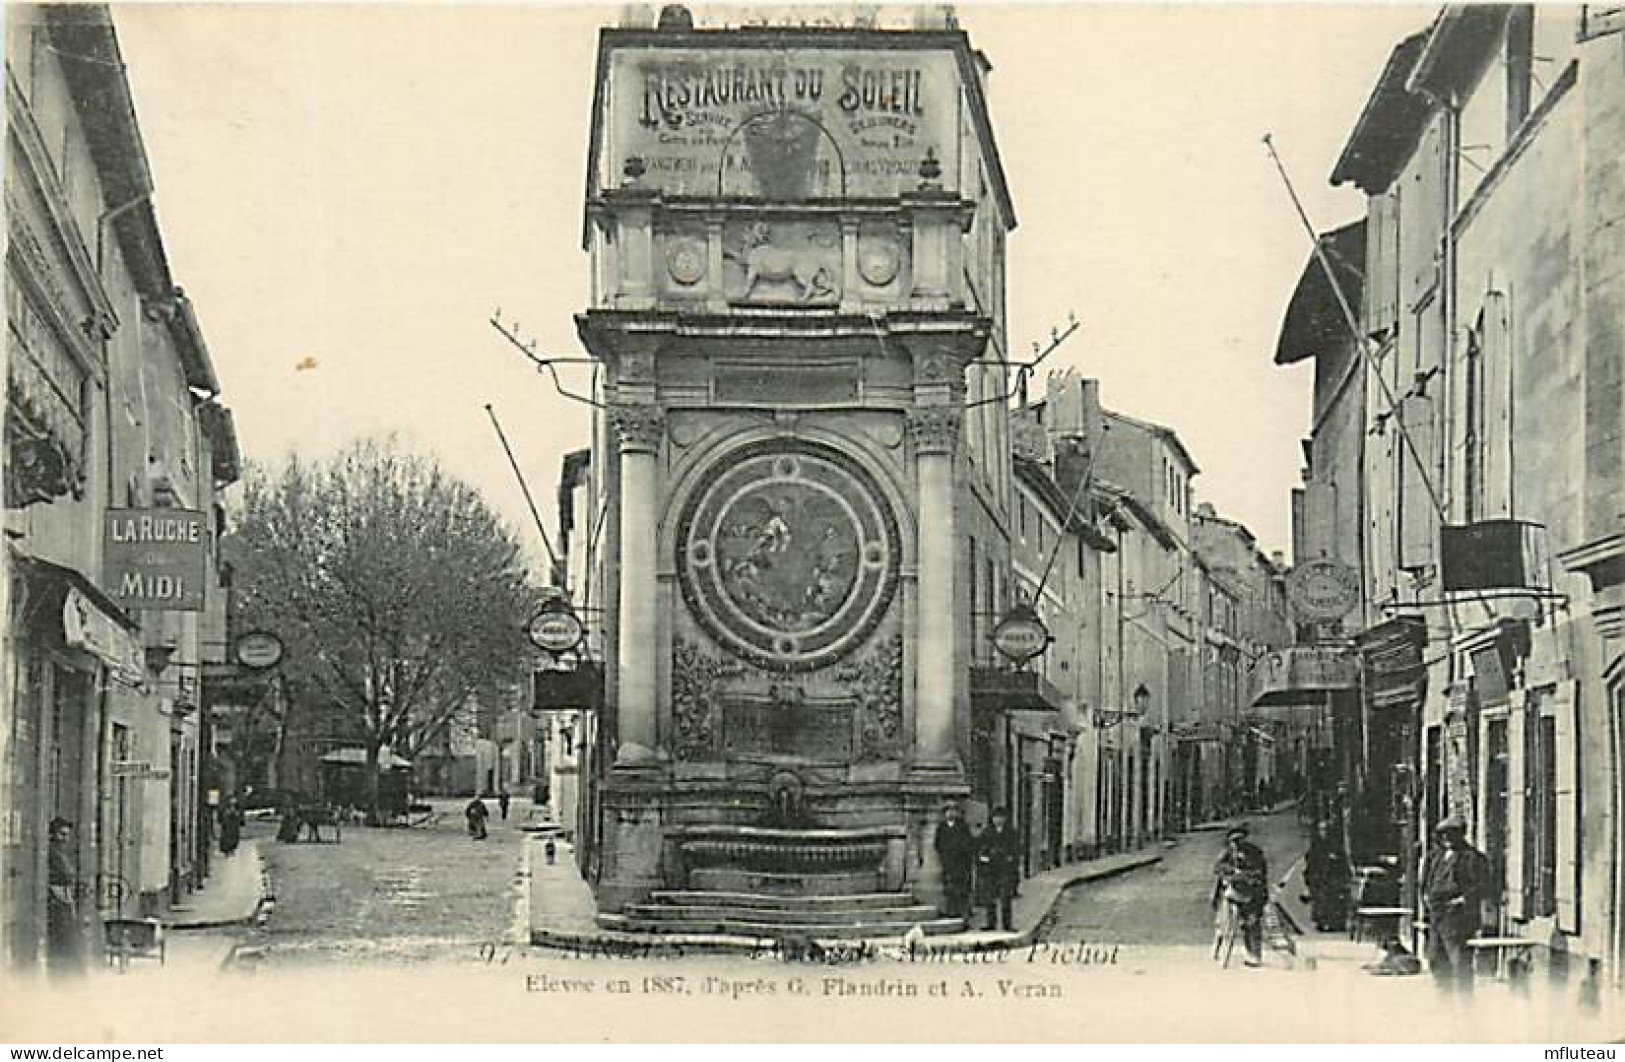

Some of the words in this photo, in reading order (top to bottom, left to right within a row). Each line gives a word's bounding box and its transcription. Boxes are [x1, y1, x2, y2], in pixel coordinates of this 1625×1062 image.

[795, 68, 824, 99] DU
[837, 65, 925, 117] SOLEIL
[113, 519, 137, 541] LA
[141, 515, 199, 543] RUCHE
[120, 572, 183, 598] MIDI
